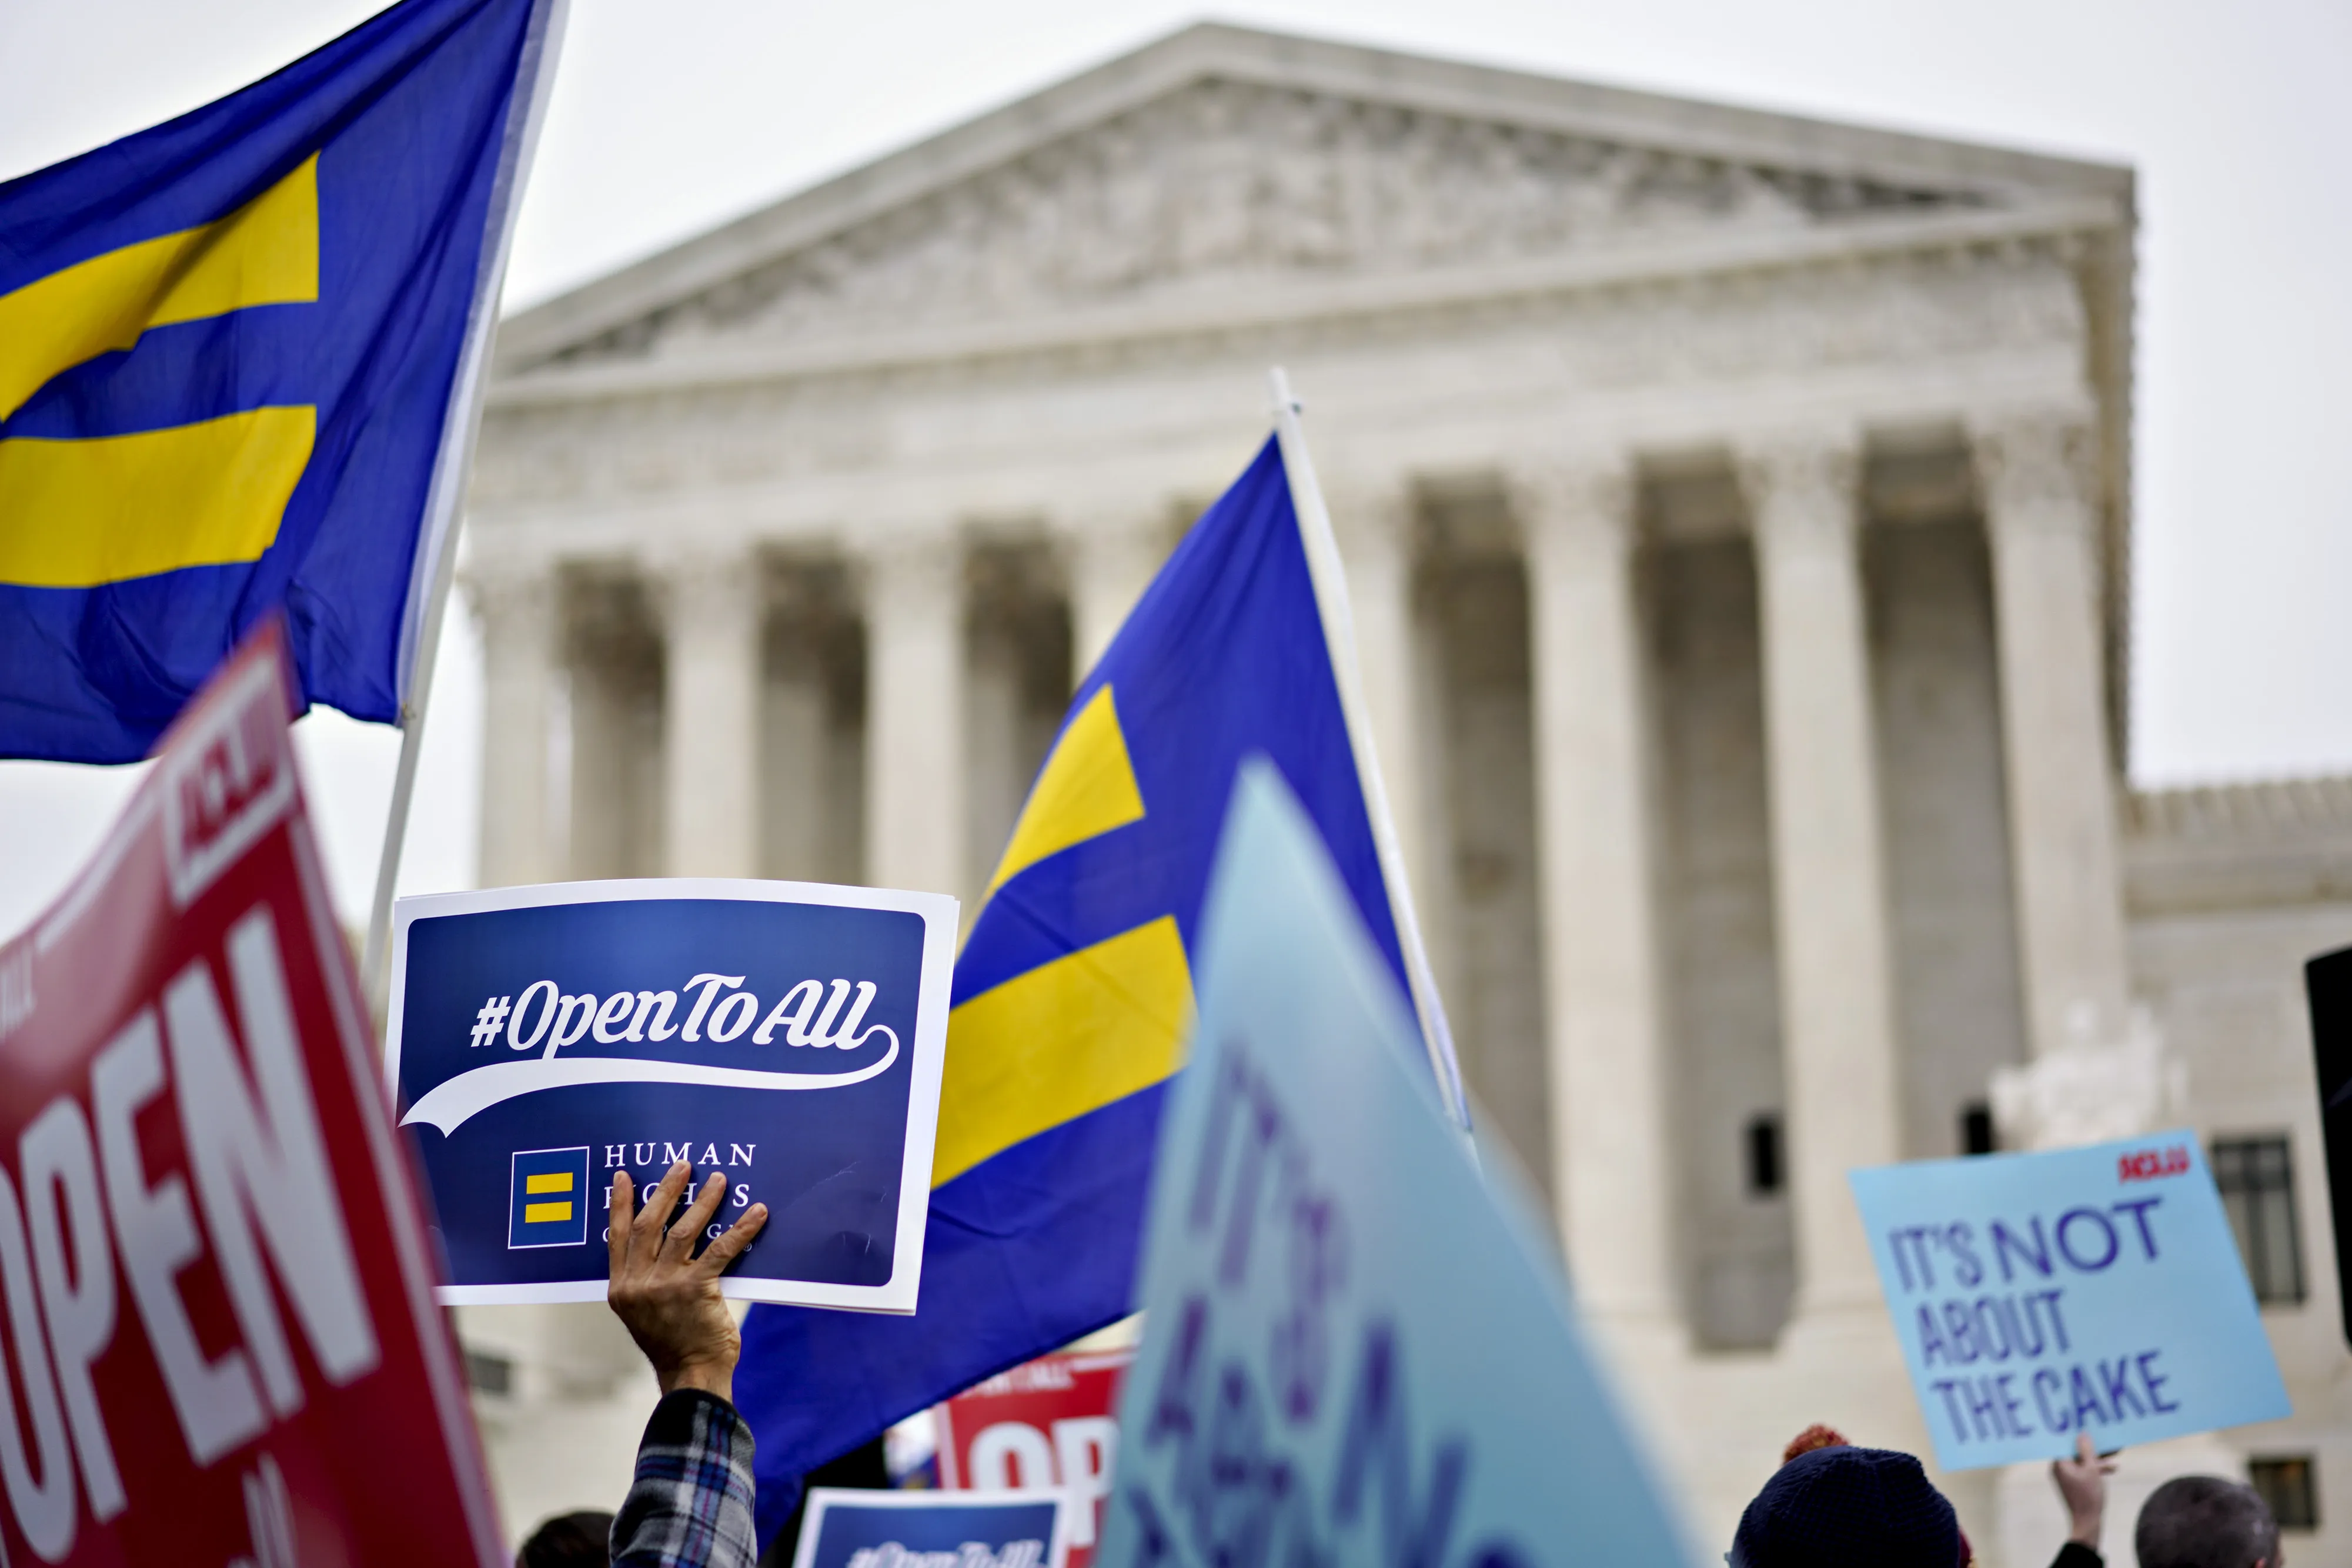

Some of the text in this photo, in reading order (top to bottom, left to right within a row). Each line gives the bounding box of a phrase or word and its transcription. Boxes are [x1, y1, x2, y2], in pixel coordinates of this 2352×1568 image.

[470, 973, 877, 1059] #OpenToAll
[604, 1142, 756, 1168] HUMAN
[1889, 1193, 2165, 1293] IT'S NOT
[1915, 1288, 2072, 1369] ABOUT
[1930, 1349, 2179, 1445] THE CAKE
[968, 1414, 1118, 1547] OP
